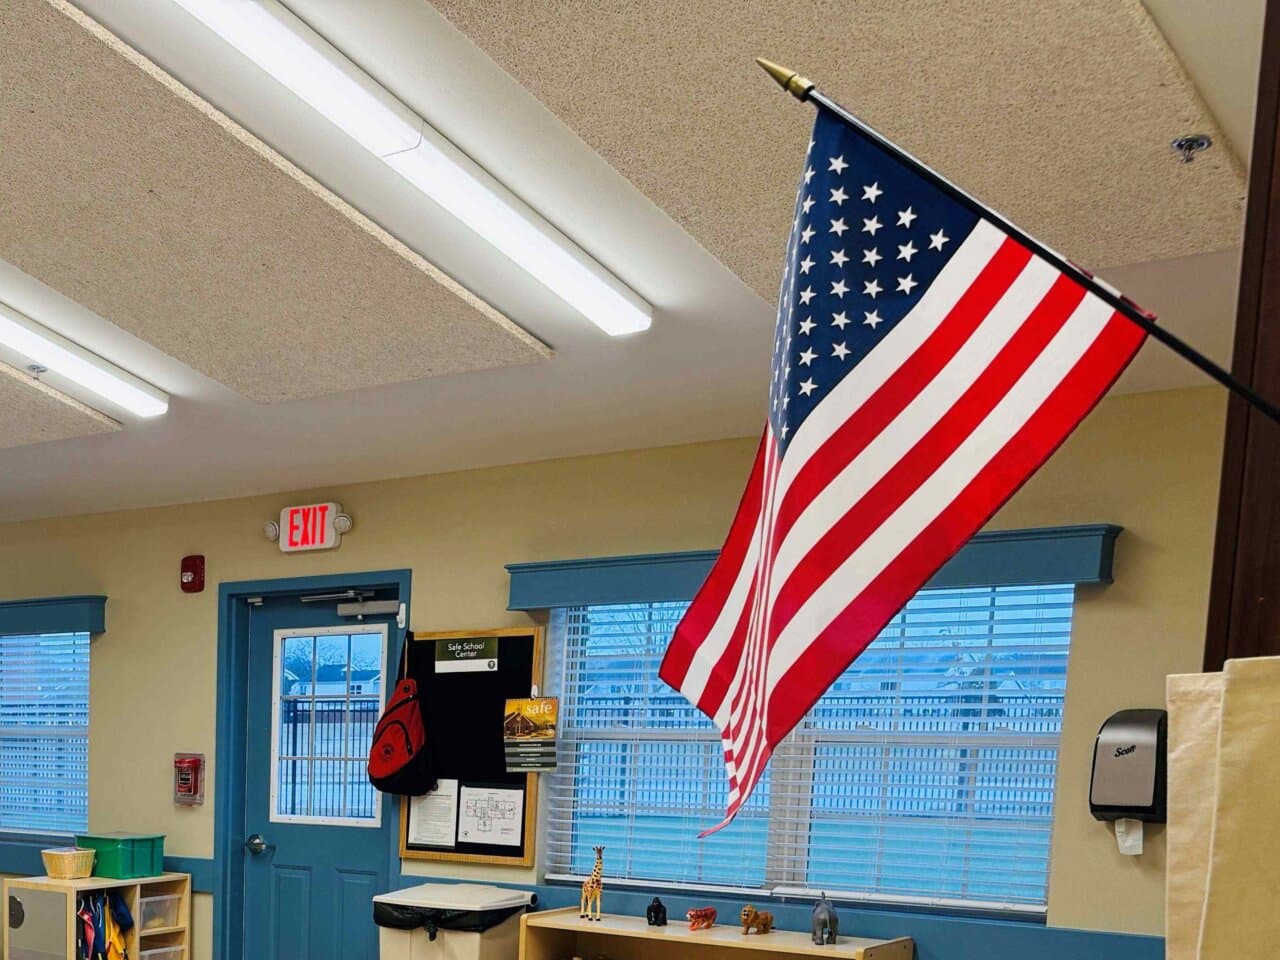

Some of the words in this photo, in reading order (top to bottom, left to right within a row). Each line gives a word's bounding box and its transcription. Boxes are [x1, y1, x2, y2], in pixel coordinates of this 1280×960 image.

[288, 505, 329, 547] EXIT
[447, 642, 462, 651] Safe
[463, 641, 485, 650] School
[455, 650, 478, 658] Center
[526, 700, 553, 714] safe
